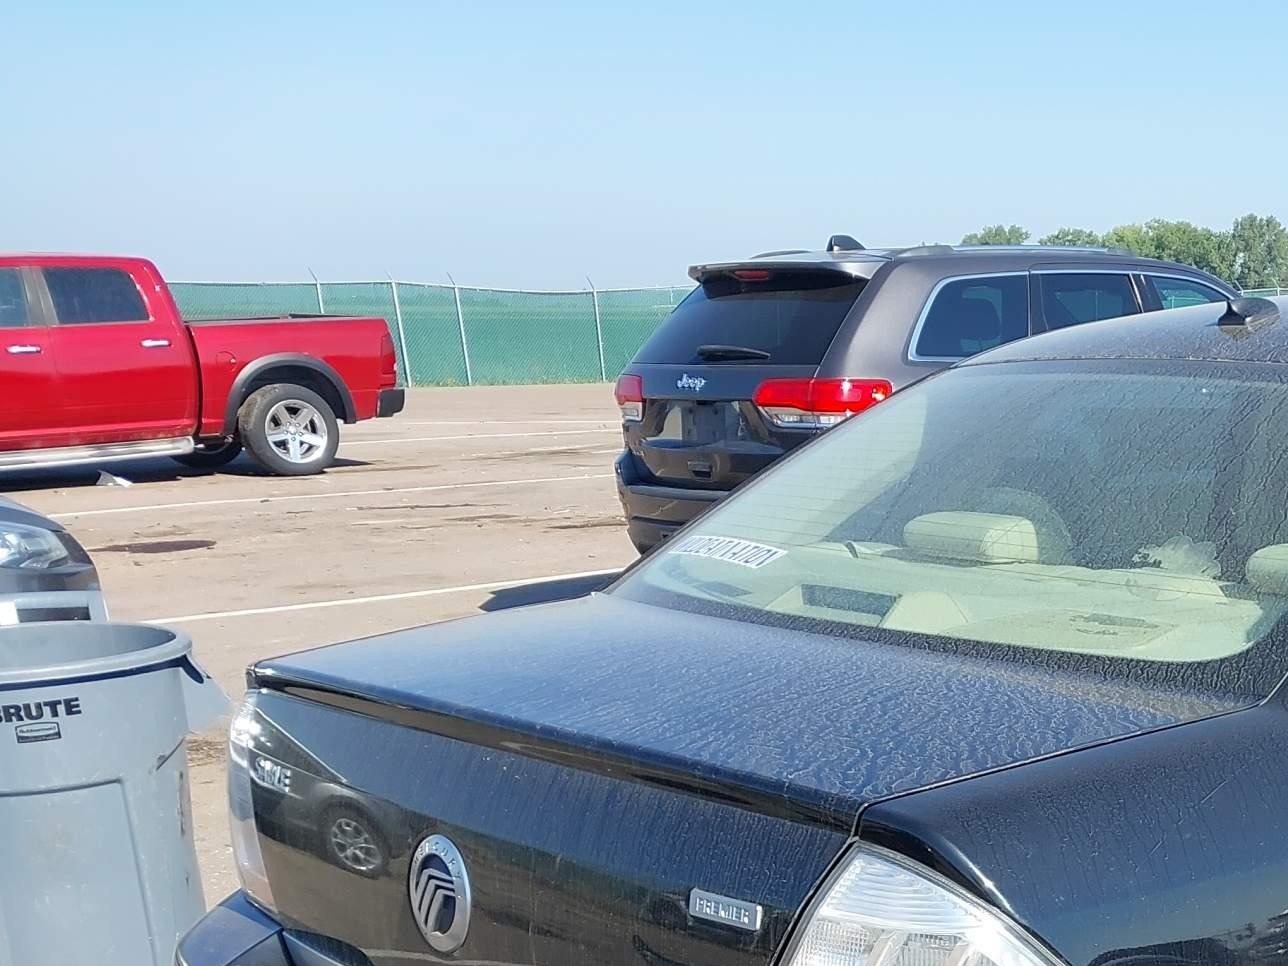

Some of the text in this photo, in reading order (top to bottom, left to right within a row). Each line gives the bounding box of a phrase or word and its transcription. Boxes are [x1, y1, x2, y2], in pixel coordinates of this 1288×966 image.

[677, 373, 706, 391] Jeep
[0, 697, 82, 723] RUTE
[695, 897, 749, 924] PREMIER
